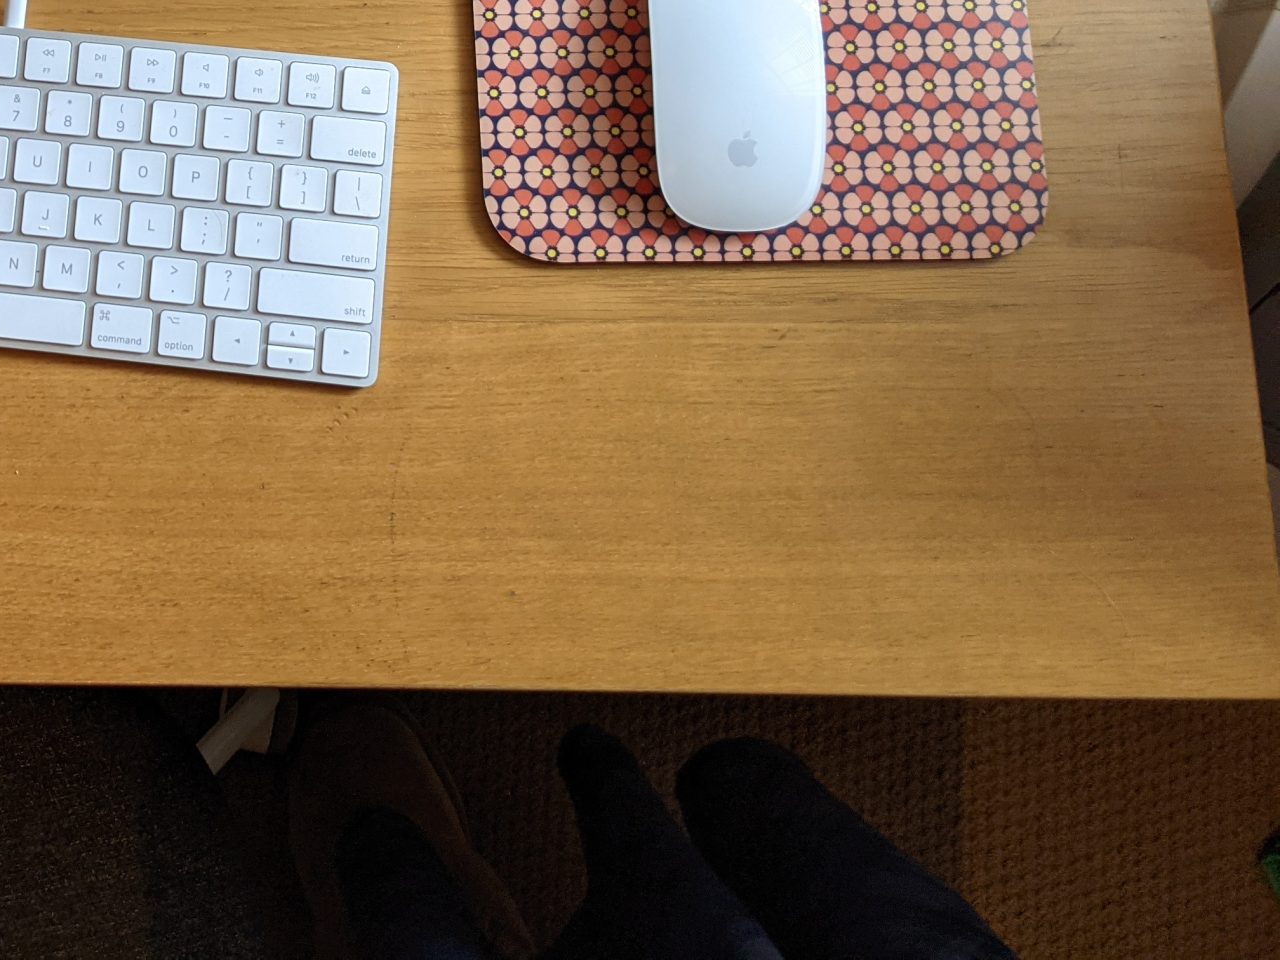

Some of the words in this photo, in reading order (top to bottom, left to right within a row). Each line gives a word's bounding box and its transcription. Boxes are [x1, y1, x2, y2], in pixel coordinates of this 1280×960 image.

[347, 148, 377, 159] delete
[33, 155, 43, 168] U
[138, 165, 148, 178] O
[191, 171, 201, 183] P
[340, 253, 370, 265] return
[344, 307, 366, 317] shift
[97, 333, 142, 347] command
[163, 340, 194, 353] option
